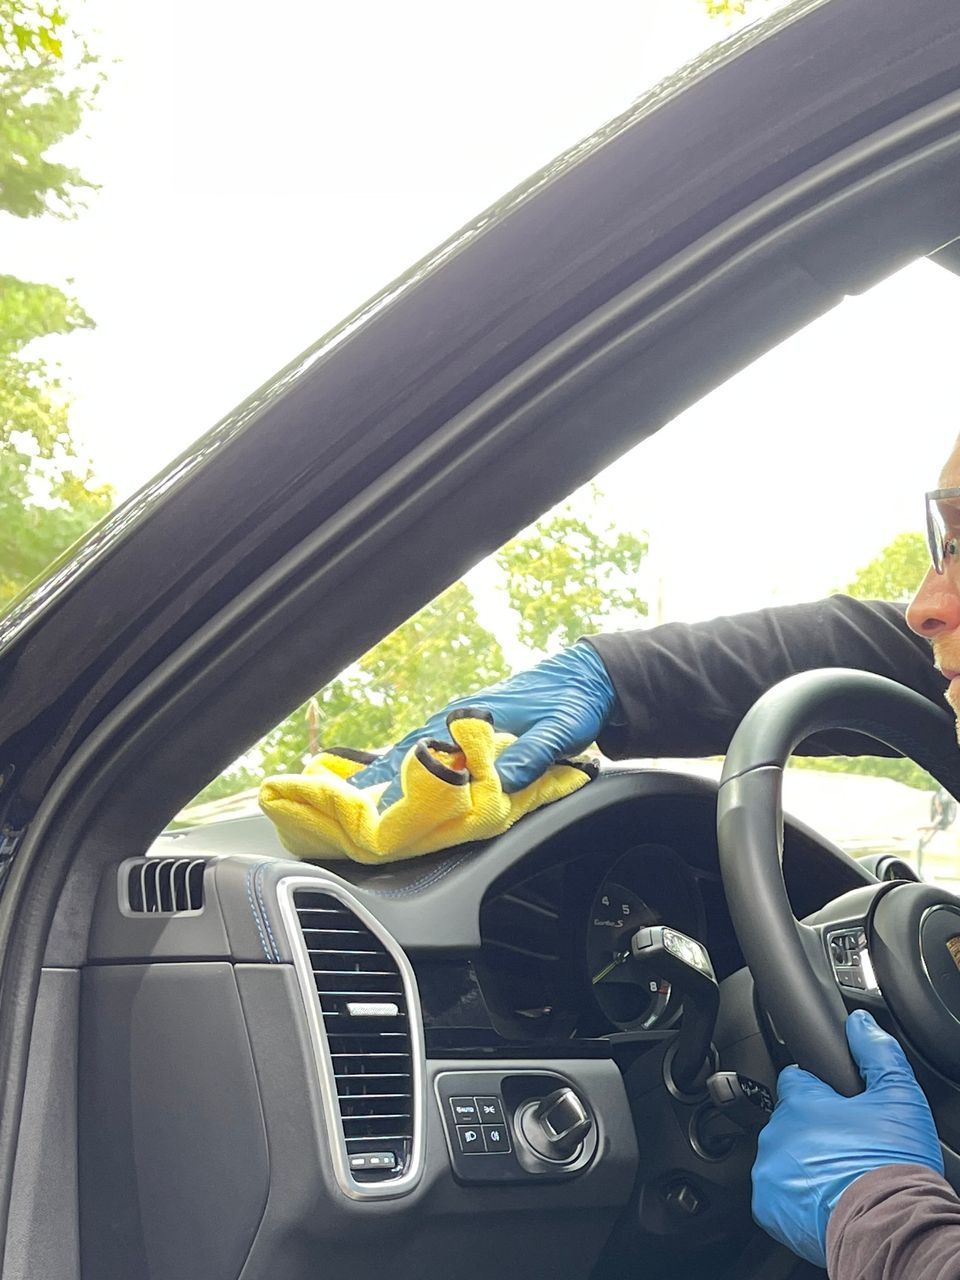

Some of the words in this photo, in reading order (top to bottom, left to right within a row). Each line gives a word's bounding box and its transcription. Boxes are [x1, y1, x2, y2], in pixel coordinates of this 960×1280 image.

[601, 896, 610, 906] 4
[622, 904, 630, 915] 5
[649, 981, 658, 992] 8
